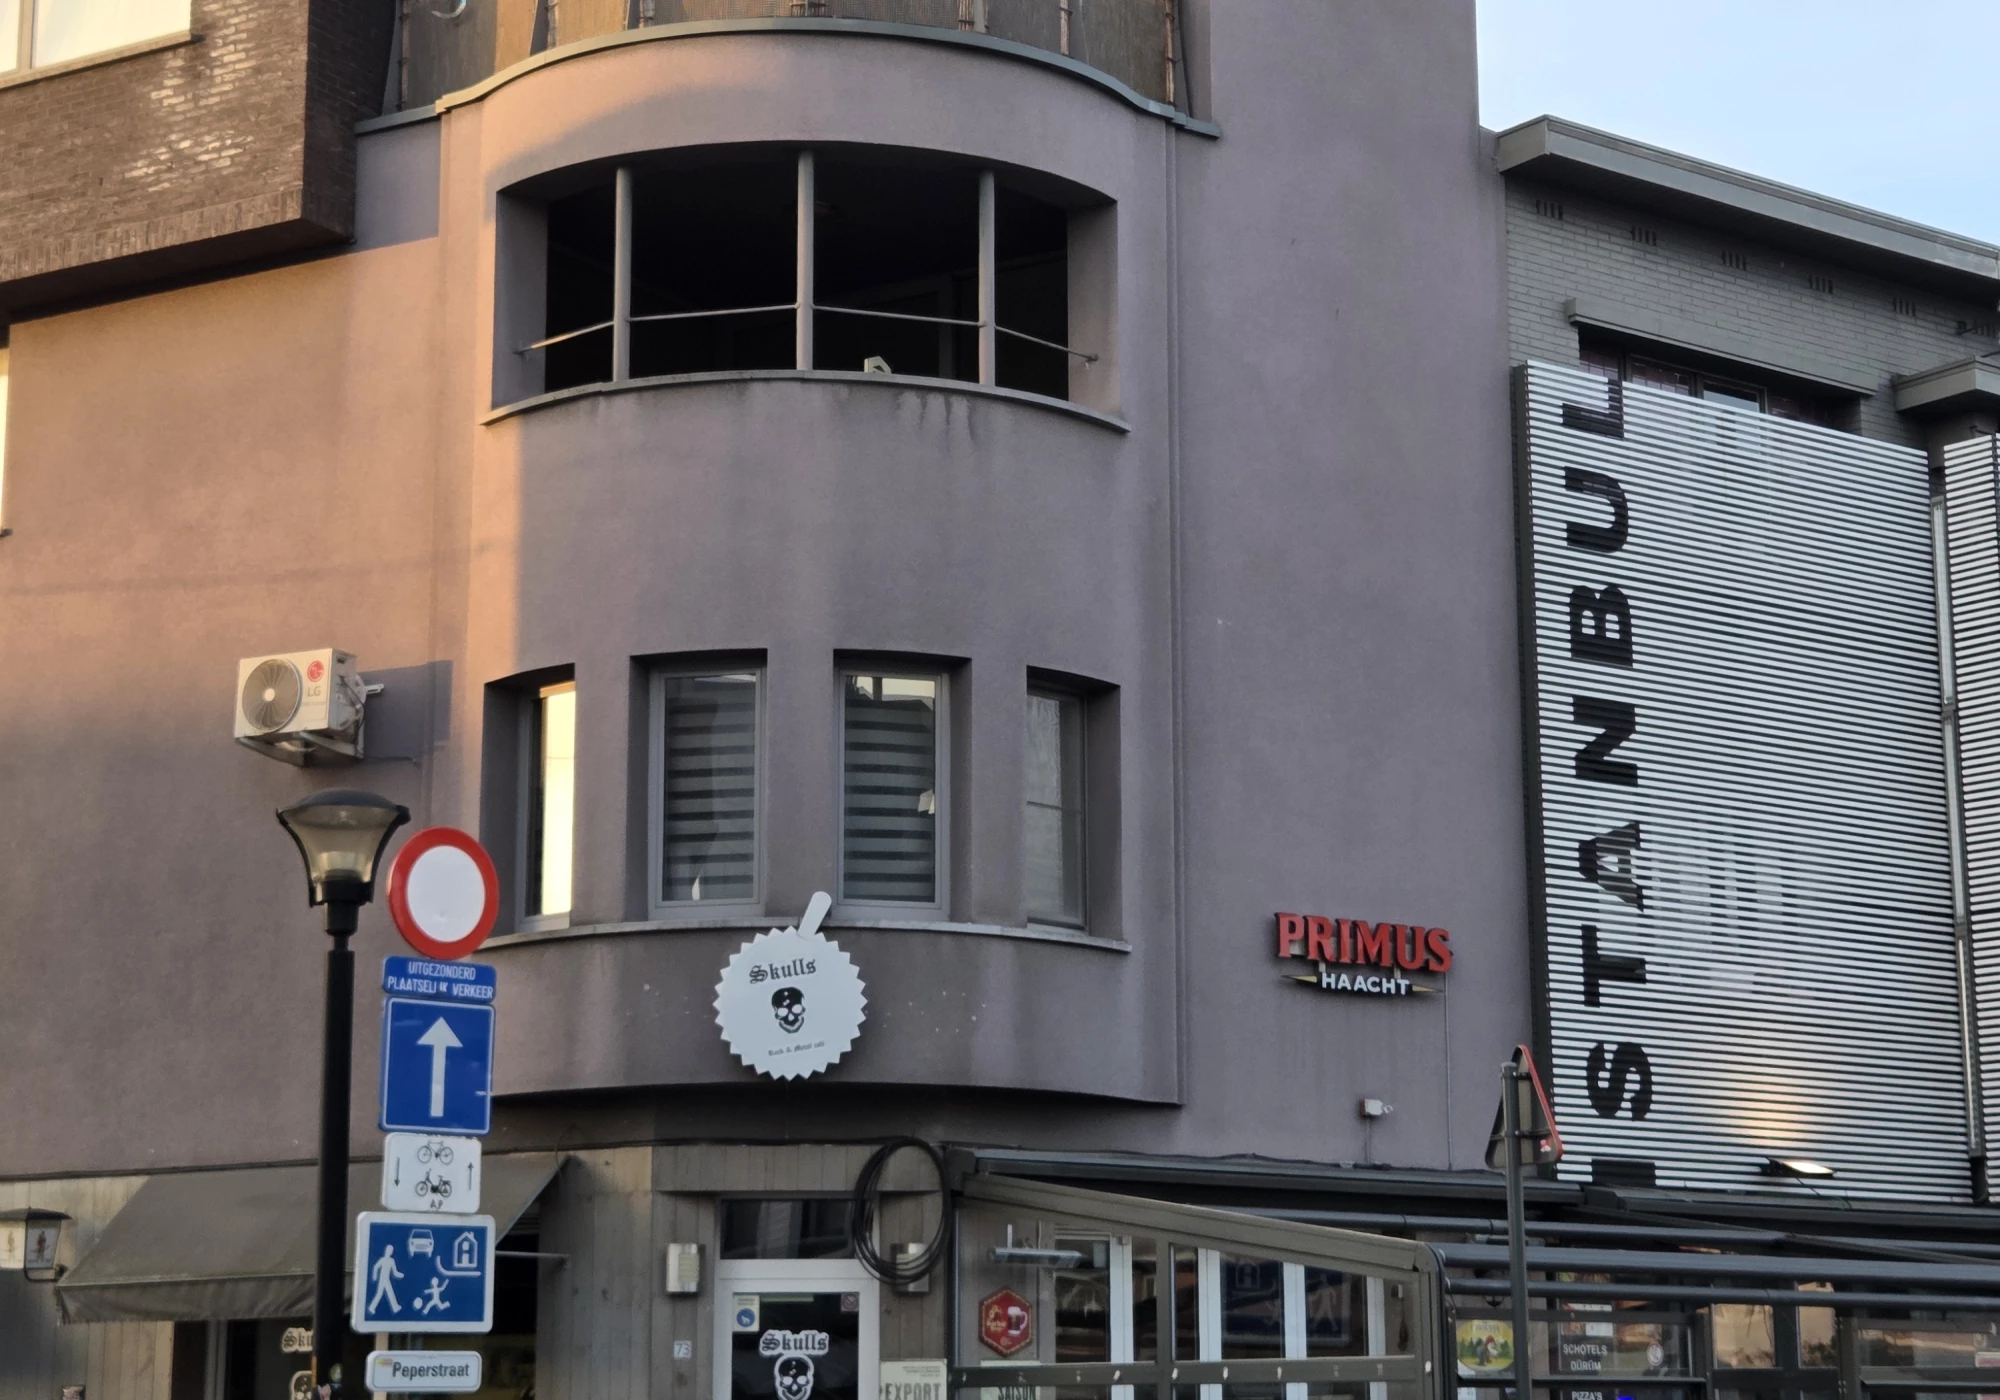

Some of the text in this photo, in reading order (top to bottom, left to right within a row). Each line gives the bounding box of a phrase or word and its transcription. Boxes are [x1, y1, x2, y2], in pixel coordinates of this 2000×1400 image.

[307, 686, 322, 697] LG
[1562, 377, 1656, 1187] ISTANBUL
[1274, 912, 1453, 973] PRIMUS
[408, 961, 476, 980] UITGEZONDERD
[749, 958, 816, 984] Skulls
[452, 982, 494, 999] VERKEER
[1321, 972, 1411, 996] HAACHT
[675, 1342, 691, 1357] 73
[761, 1332, 828, 1351] Skulls
[1562, 1344, 1608, 1357] SCHOTELS
[392, 1361, 470, 1381] Peperstraat
[885, 1383, 942, 1400] EXPORT
